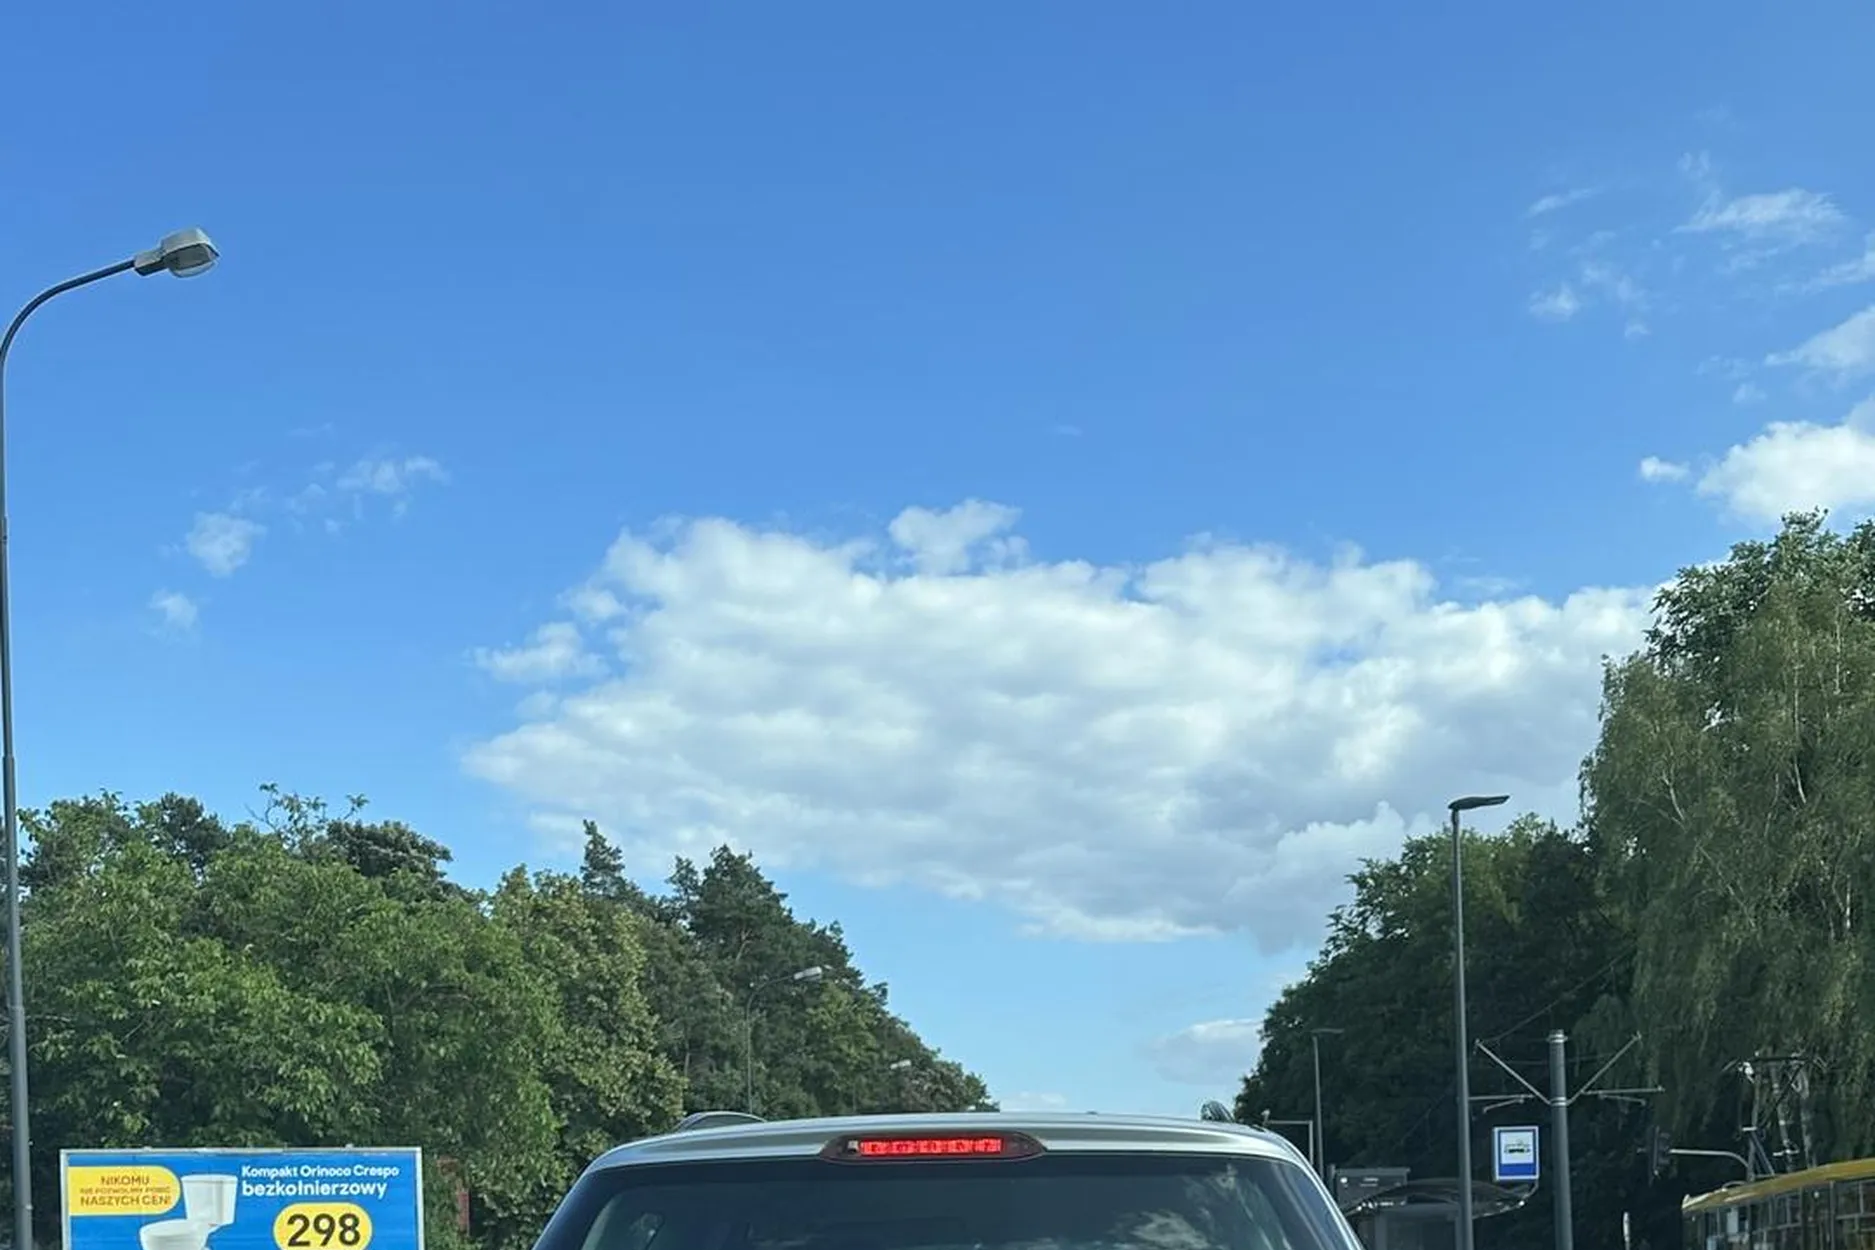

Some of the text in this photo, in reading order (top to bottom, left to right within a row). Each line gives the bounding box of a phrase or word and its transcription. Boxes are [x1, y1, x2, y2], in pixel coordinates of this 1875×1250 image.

[241, 1164, 399, 1180] Kompakt Orinoco Crespo
[100, 1175, 149, 1186] NIKOMU
[80, 1195, 140, 1206] NASZYCH
[287, 1213, 361, 1247] 298
